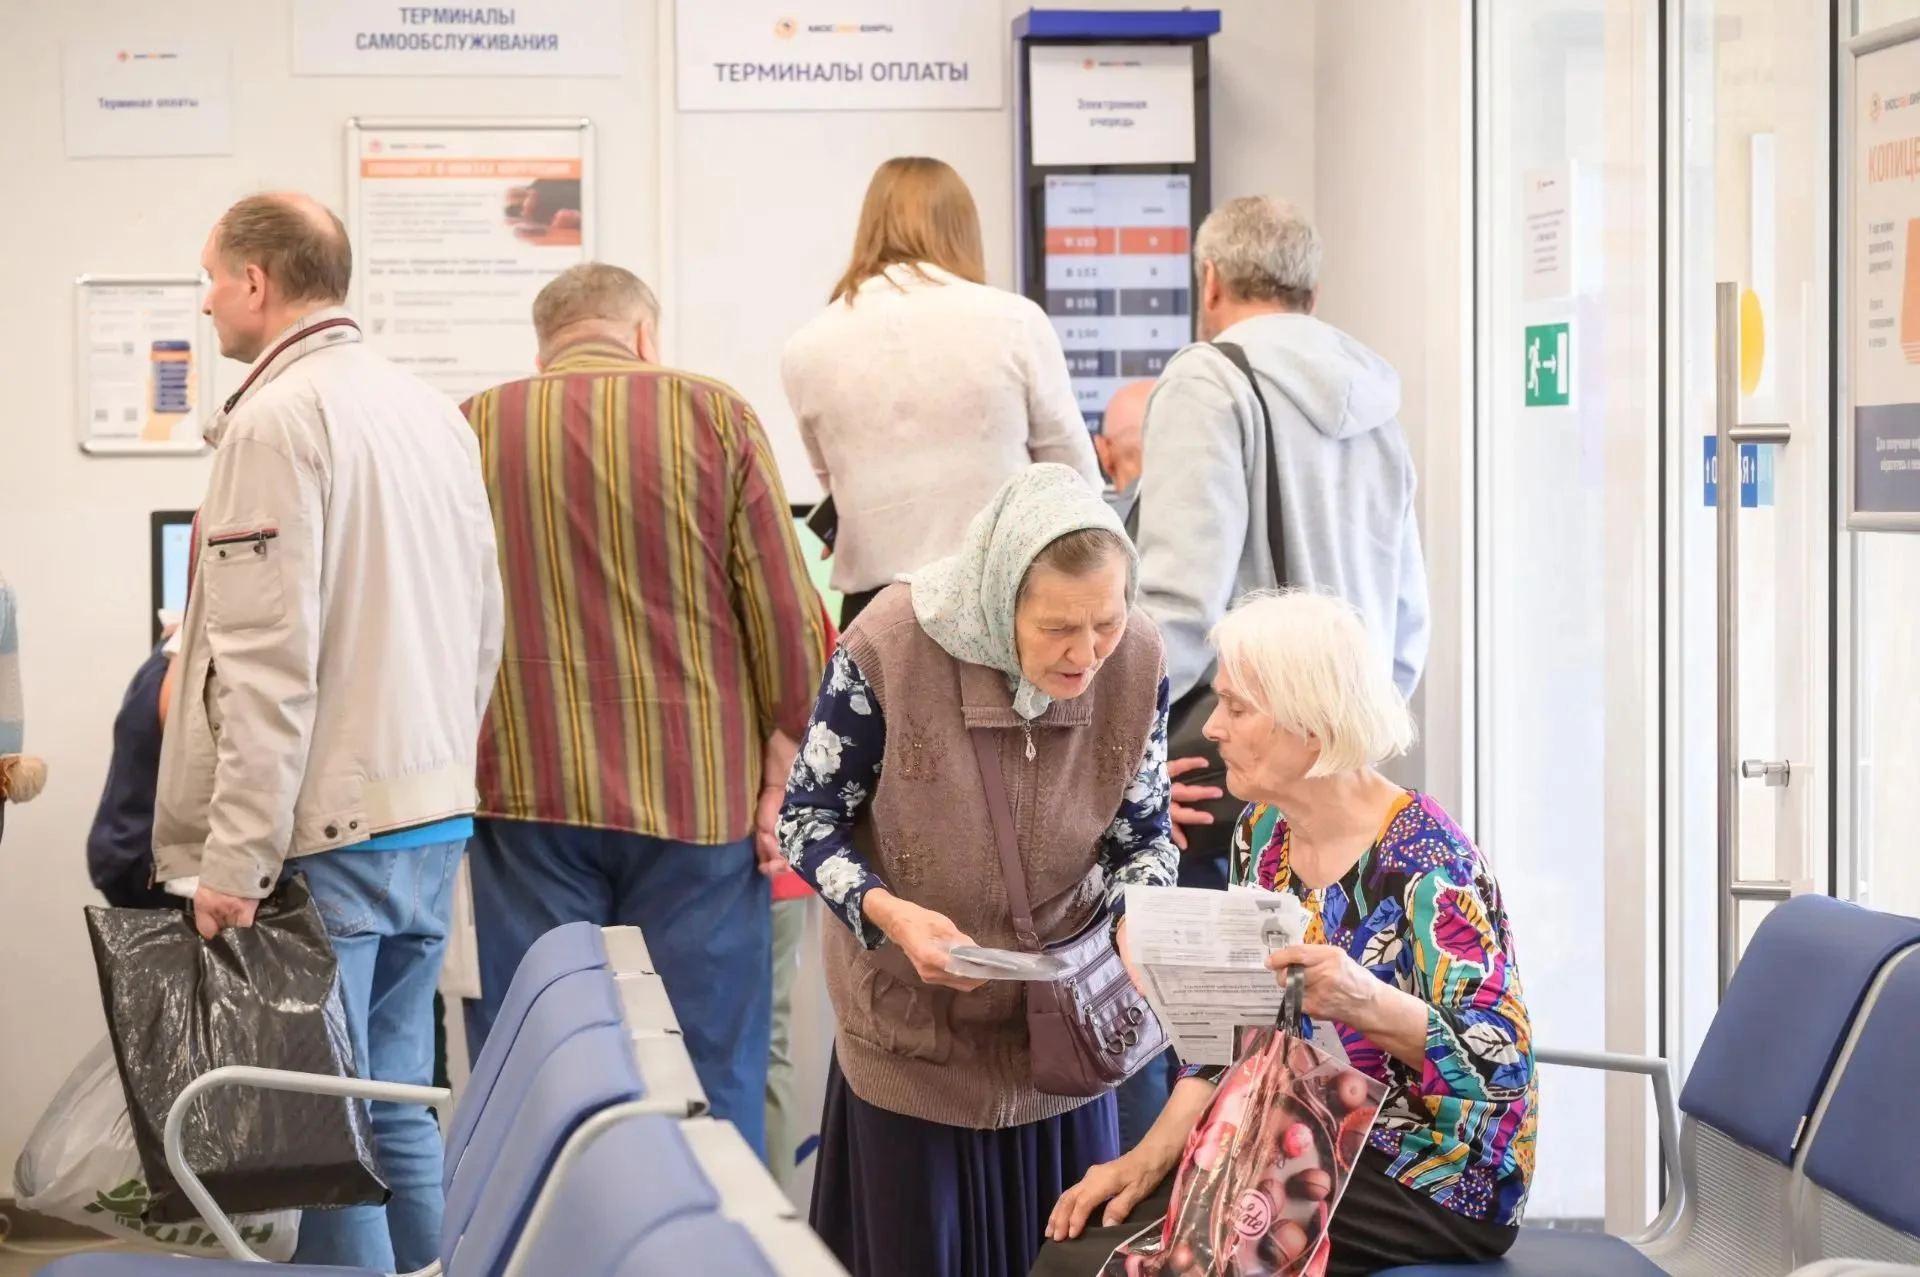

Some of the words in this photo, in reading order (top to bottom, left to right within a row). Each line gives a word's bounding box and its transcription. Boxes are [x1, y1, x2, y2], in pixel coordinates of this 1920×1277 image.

[399, 7, 515, 25] ТЕРМИНАЛЫ
[355, 32, 559, 51] САМООБСЛУЖИВАНИЯ
[713, 62, 863, 82] ТЕРМИНАЛЫ
[870, 62, 969, 82] ОПЛАТЫ
[98, 97, 153, 110] Терминал
[156, 97, 199, 108] оплаты
[1077, 98, 1148, 111] Электронная
